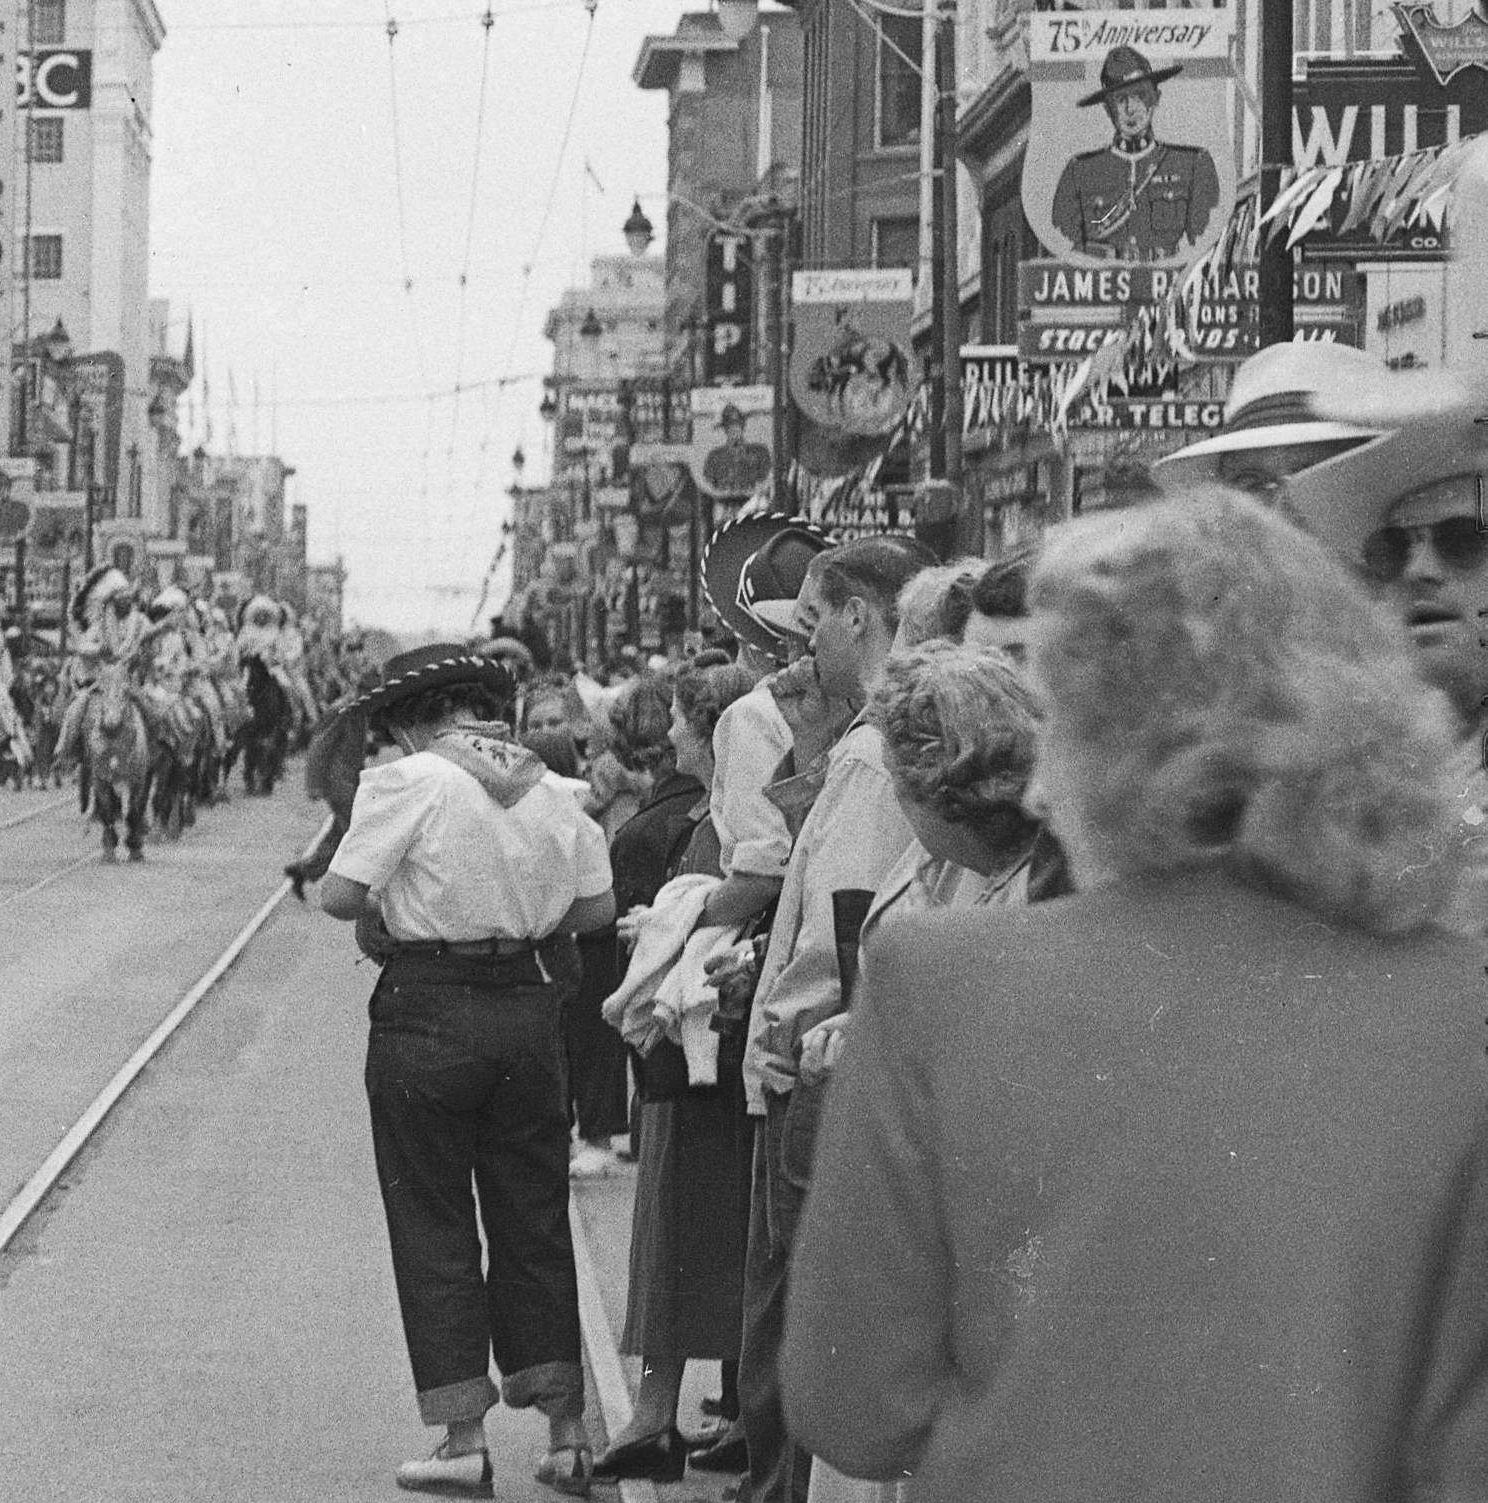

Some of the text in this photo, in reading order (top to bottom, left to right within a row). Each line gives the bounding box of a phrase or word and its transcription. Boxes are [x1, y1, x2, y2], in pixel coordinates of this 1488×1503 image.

[1084, 19, 1212, 48] Anniversary
[1034, 270, 1131, 302] JAMES
[1201, 304, 1238, 324] ONS
[1039, 329, 1126, 351] STOCK
[1129, 404, 1224, 427] TELEG
